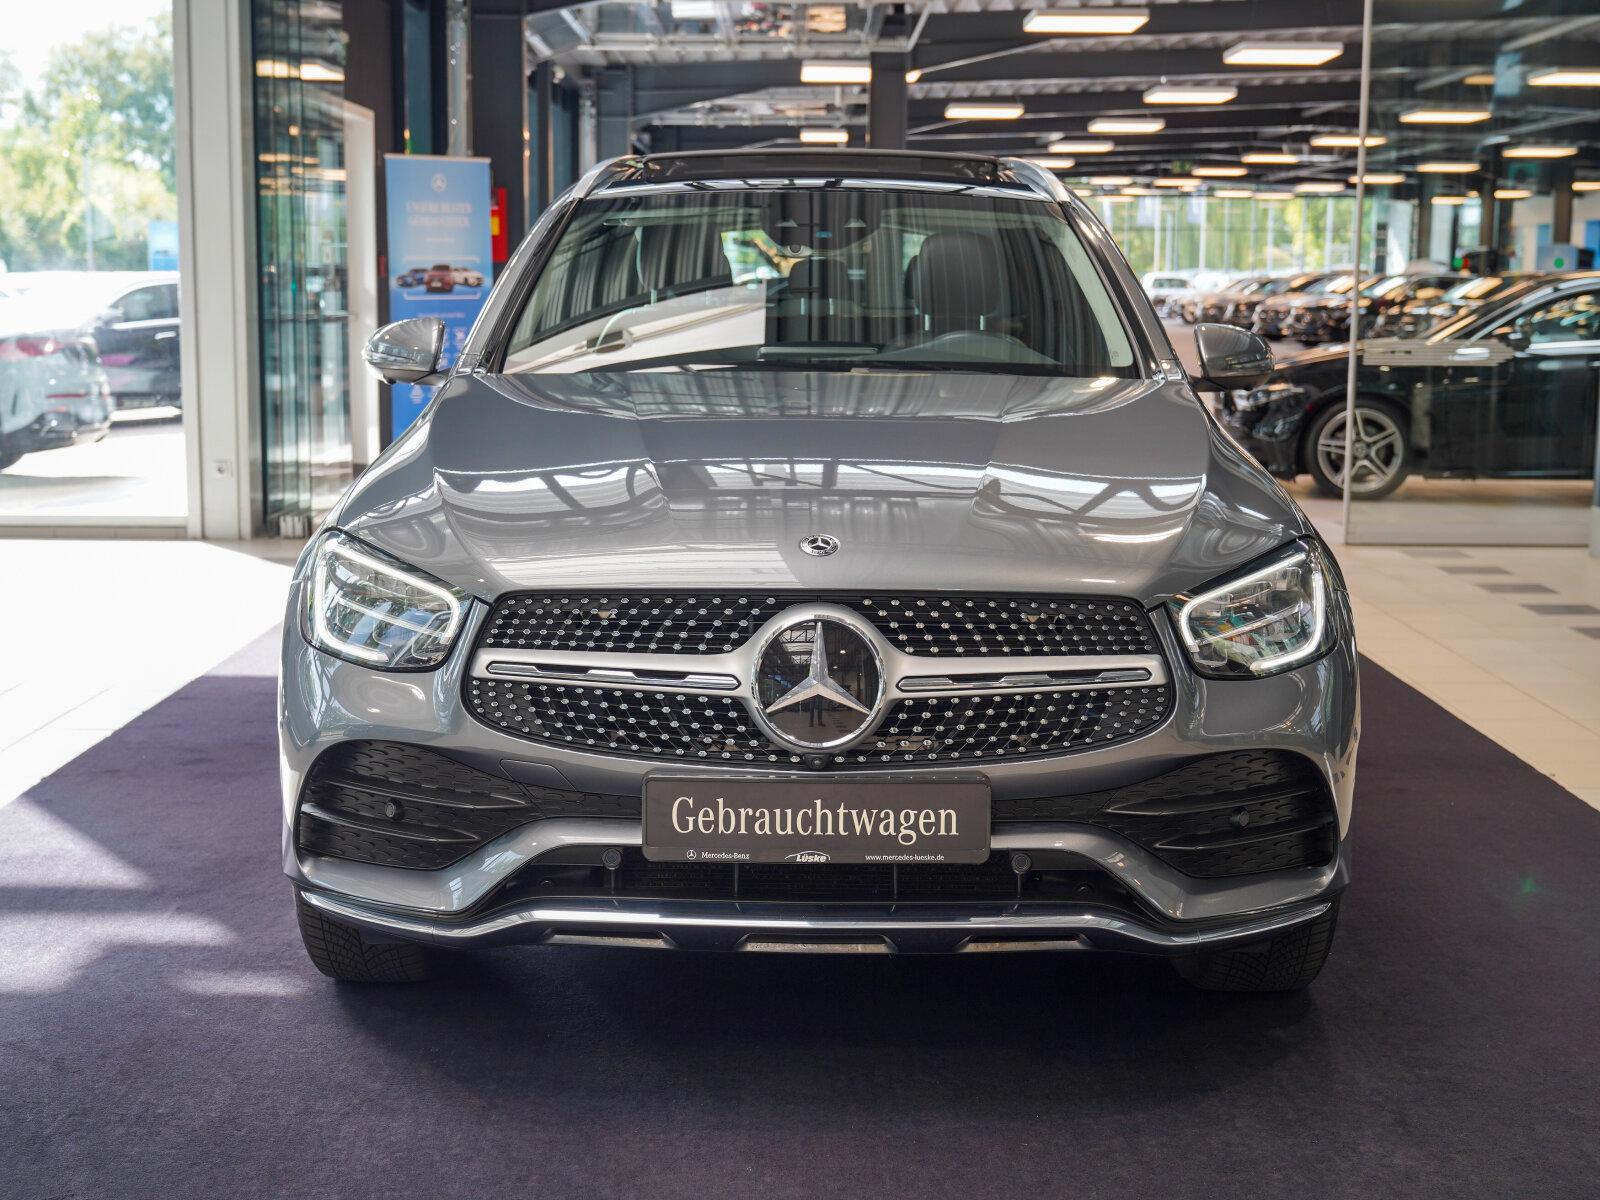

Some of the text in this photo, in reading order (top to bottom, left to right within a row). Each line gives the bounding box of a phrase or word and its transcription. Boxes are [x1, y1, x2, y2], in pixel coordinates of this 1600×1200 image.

[671, 797, 960, 845] Gebrauchtwagen
[701, 851, 750, 860] Mercedes-Benz
[865, 853, 945, 862] www.mercedes-lueske.de
